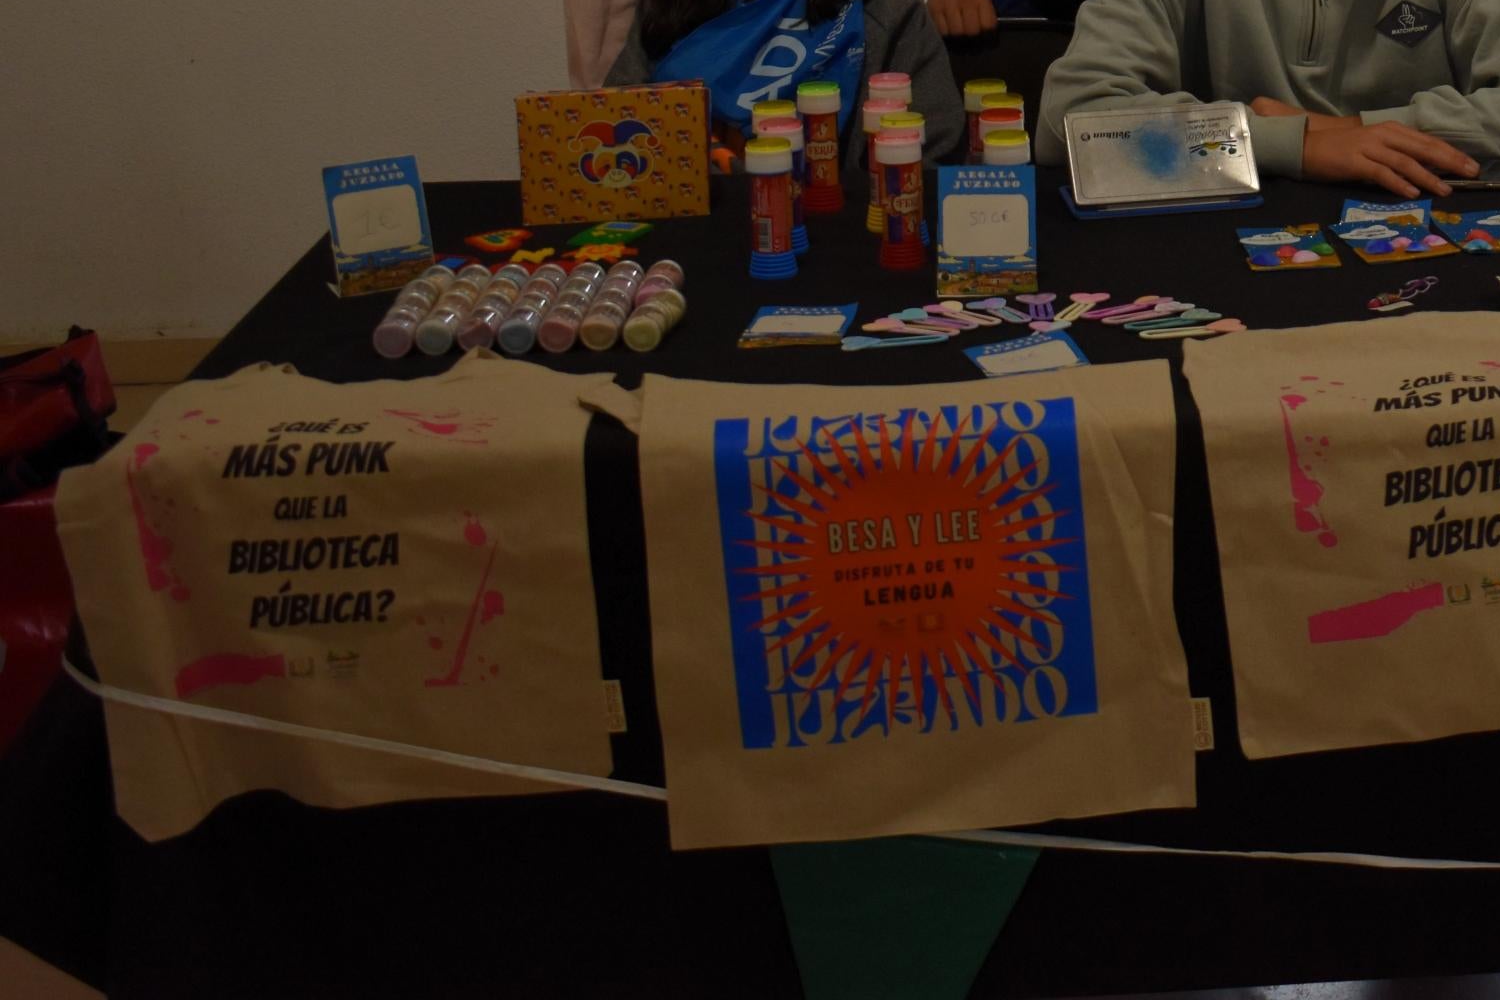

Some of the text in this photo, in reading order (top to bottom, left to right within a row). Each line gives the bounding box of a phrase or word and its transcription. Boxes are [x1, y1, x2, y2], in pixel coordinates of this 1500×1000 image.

[339, 170, 406, 189] JUZBADO
[343, 161, 401, 178] REGALA
[956, 170, 1017, 180] REGALA
[952, 180, 1022, 190] JUZBADO
[1400, 371, 1487, 391] ¿QUÉ ES
[1373, 389, 1442, 412] MÁS
[268, 418, 370, 434] ¿QUÉ ES
[1426, 417, 1495, 447] QUE LA
[222, 434, 396, 478] MÁS PUNK
[273, 495, 347, 522] QUE LA
[827, 508, 983, 554] BESA Y LEE
[228, 531, 400, 575] BIBLIOTECA
[834, 556, 975, 583] DISFRUTA DE TU
[249, 581, 396, 628] PÚBLICA?
[863, 580, 956, 607] LENGUA
